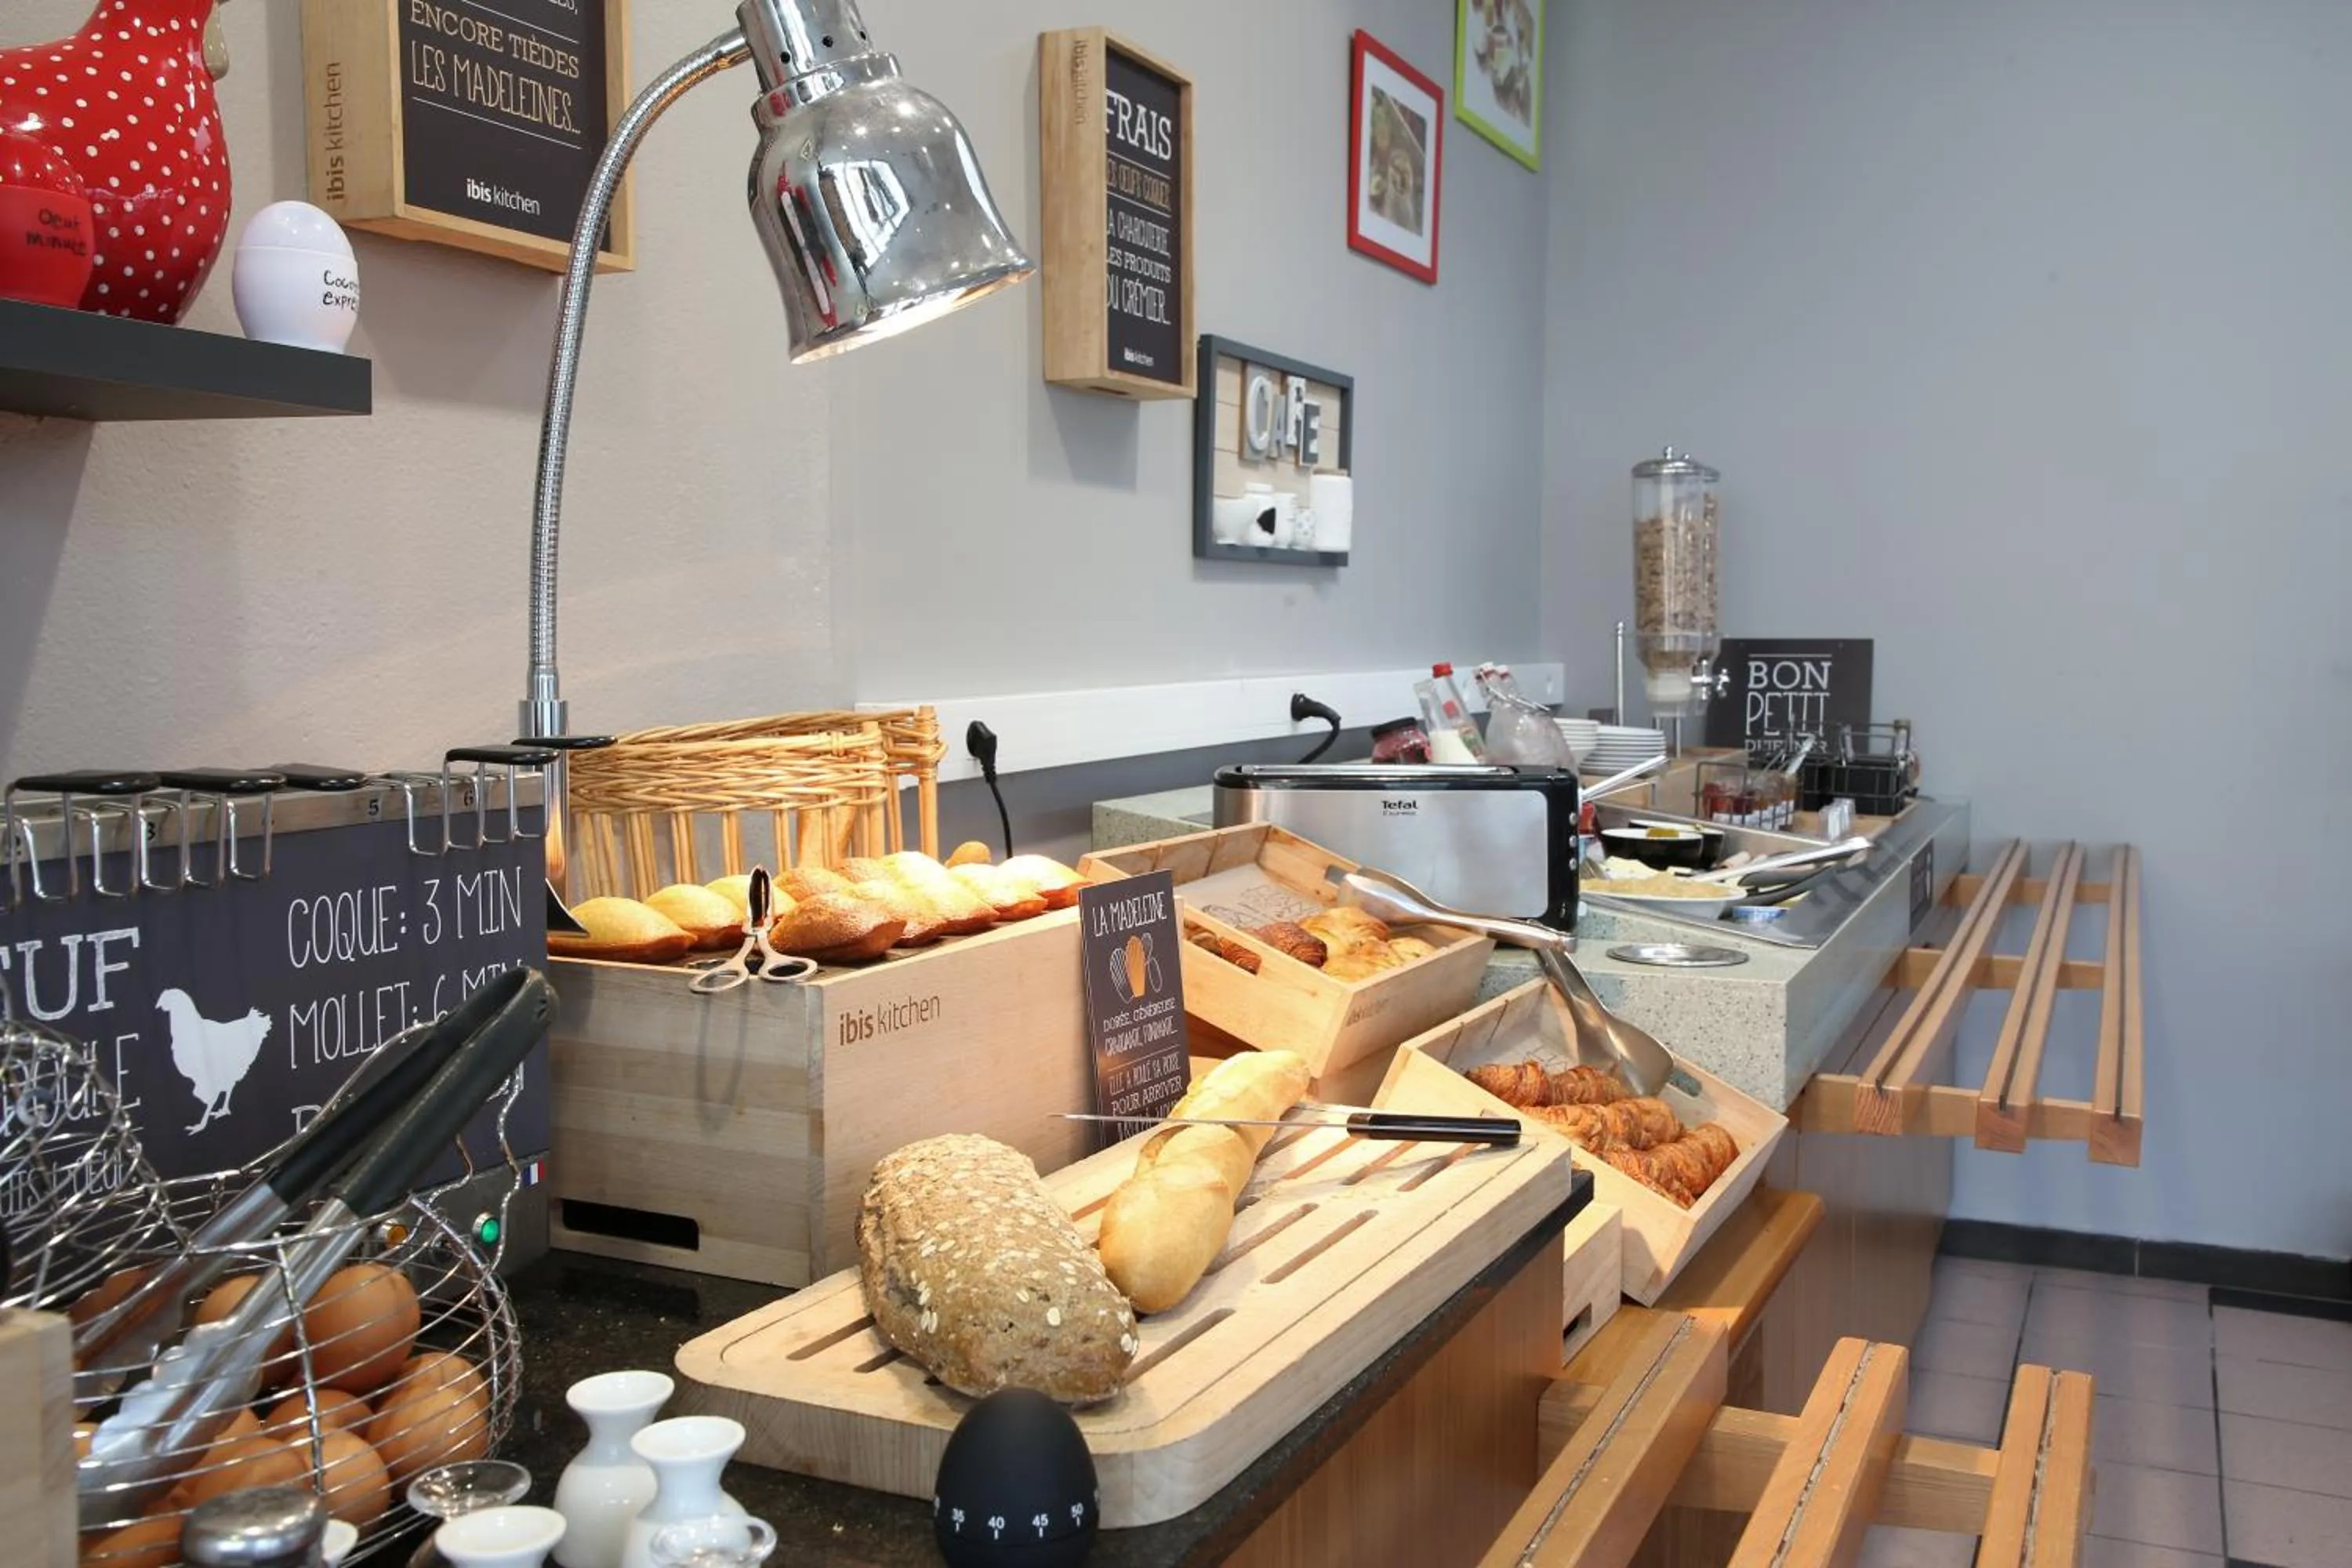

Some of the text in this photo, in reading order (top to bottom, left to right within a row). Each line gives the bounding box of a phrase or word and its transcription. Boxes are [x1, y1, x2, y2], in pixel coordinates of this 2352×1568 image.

[410, 0, 580, 79] ENCORE TIÈDES
[411, 40, 446, 93] LES
[325, 62, 346, 202] ibis kitchen
[466, 179, 540, 216] ibis kitchen
[1748, 661, 1832, 690] BON
[1745, 691, 1831, 737] PETIT
[367, 798, 379, 816] 5
[1381, 800, 1418, 810] Tefal
[423, 879, 442, 946] 3
[456, 866, 522, 939] MIN
[1092, 891, 1167, 938] LA MADELEINE
[0, 927, 140, 1021] UF
[840, 995, 941, 1047] ibis kitchen
[1142, 1076, 1184, 1107] ARRIVER
[952, 1502, 1083, 1530] 35 40 45 50
